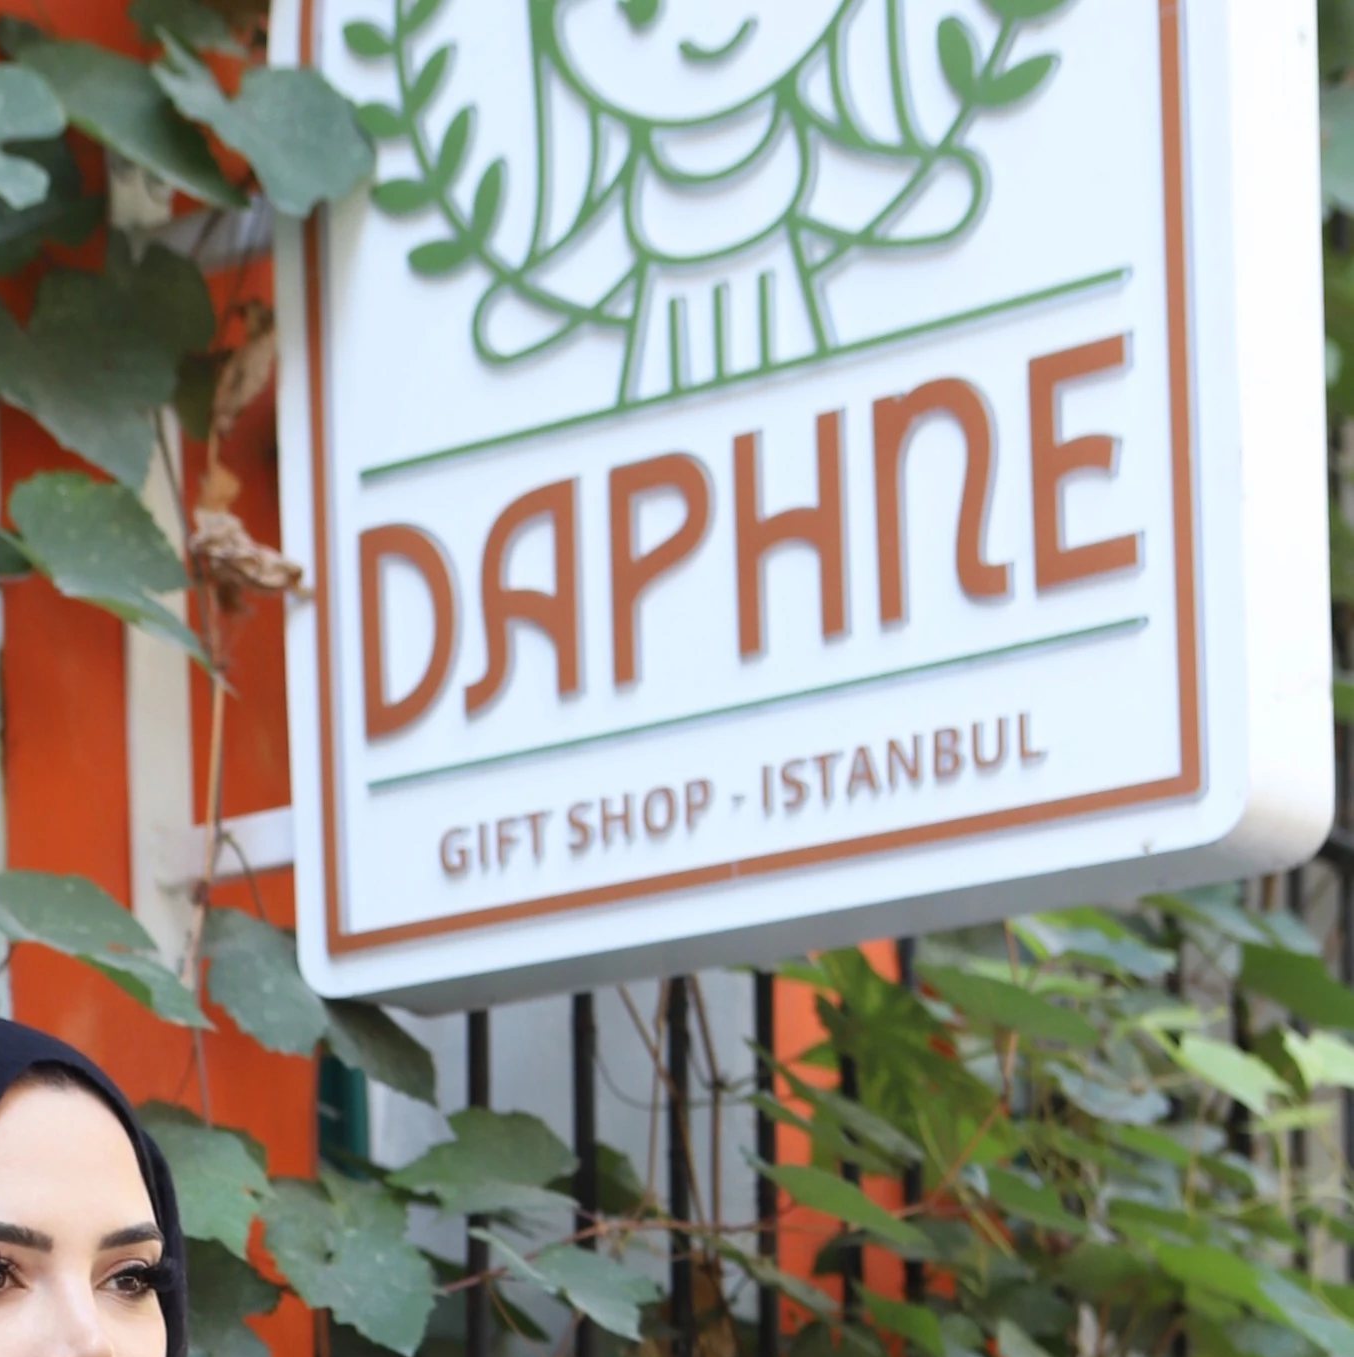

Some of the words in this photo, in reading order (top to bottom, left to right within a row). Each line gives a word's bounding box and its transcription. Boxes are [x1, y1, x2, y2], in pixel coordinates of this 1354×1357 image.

[358, 332, 1139, 743] DAPHNE
[440, 810, 550, 874] GIFT
[567, 778, 713, 850] SHOP
[762, 713, 1044, 812] ISTANBUL
